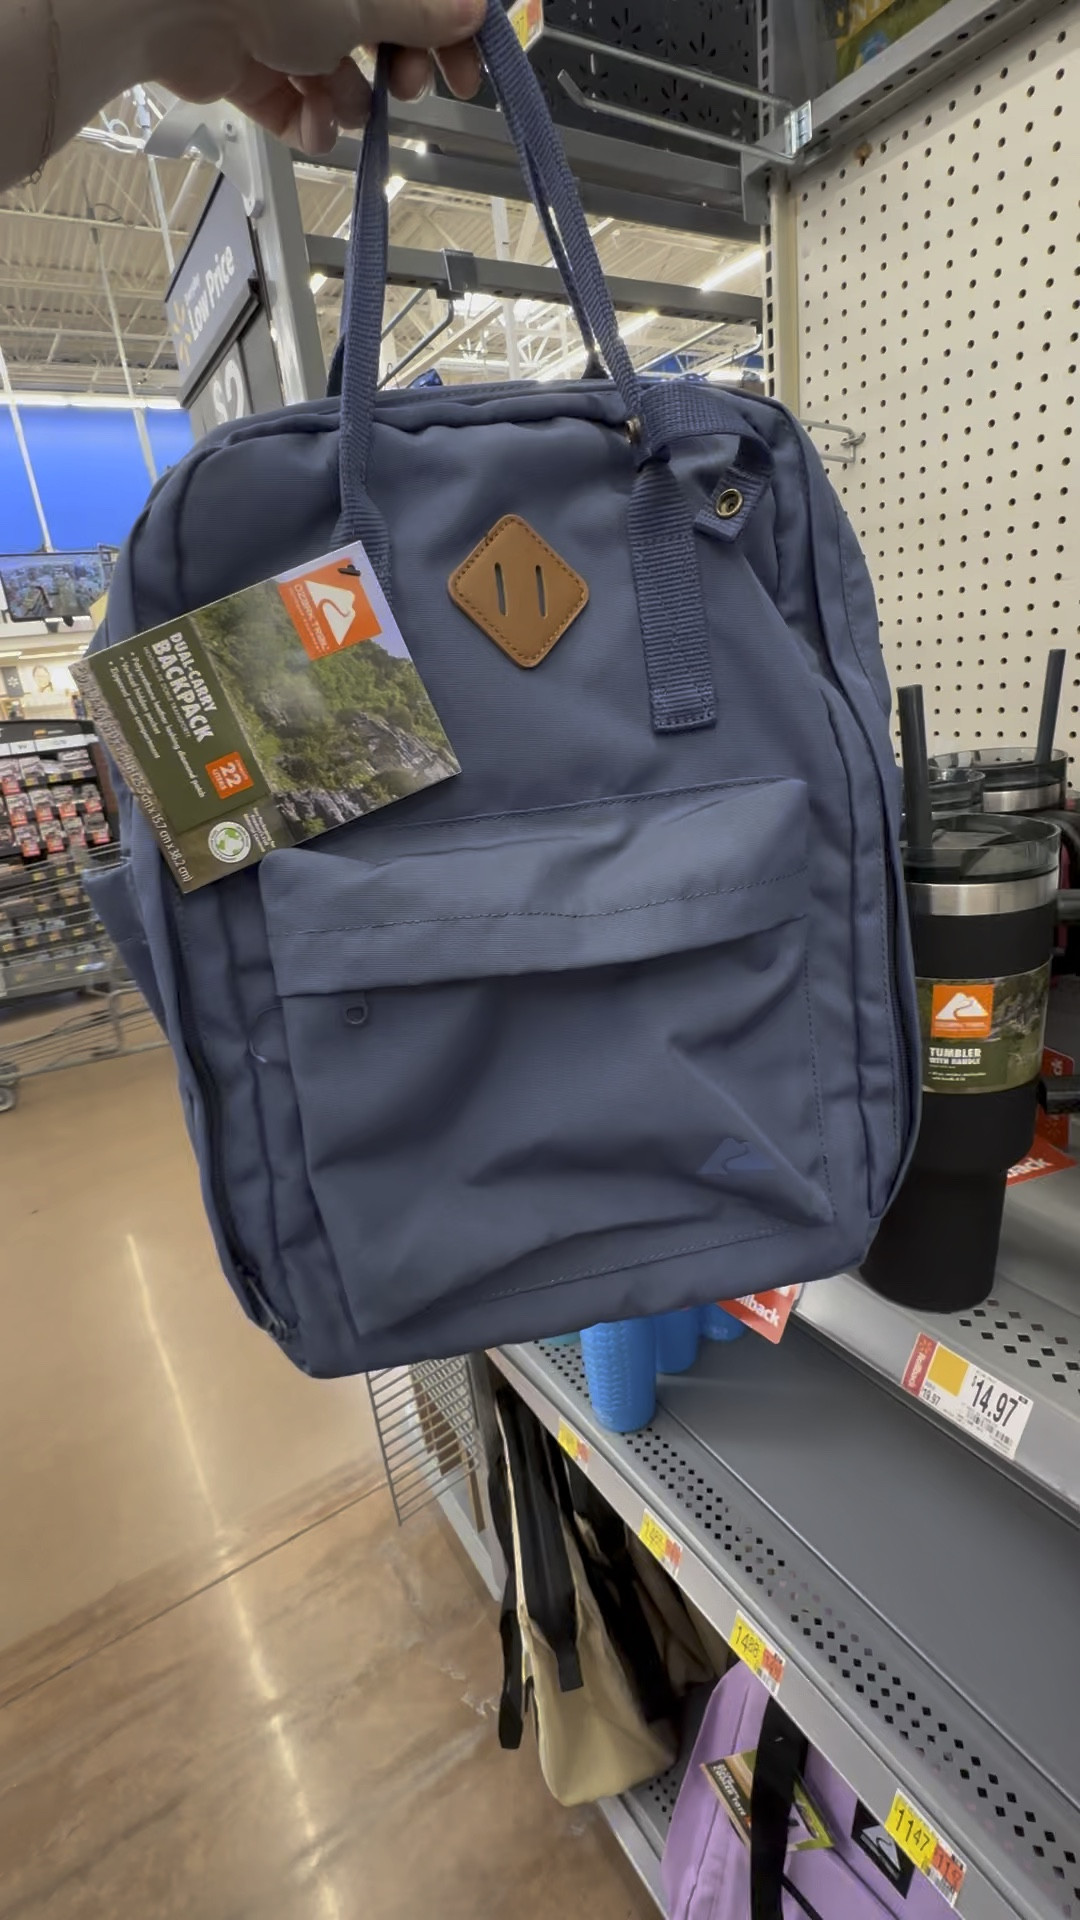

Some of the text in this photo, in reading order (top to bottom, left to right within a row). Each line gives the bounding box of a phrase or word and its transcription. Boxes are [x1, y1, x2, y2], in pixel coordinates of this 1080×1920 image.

[188, 285, 210, 340] Low
[205, 246, 235, 308] Price
[109, 665, 160, 760] Zippered main compartment
[121, 661, 160, 735] Vertical hidden pocket
[150, 636, 214, 743] BACKPACK
[169, 630, 217, 714] DUAL-CARRY
[130, 655, 205, 798] Polyurethane leather lashing diamond patch
[219, 760, 243, 788] 22
[151, 812, 166, 830] 15.7
[159, 828, 172, 844] cm
[168, 846, 184, 867] 38.2
[176, 864, 193, 883] cm)
[929, 1047, 981, 1058] TUMBLER
